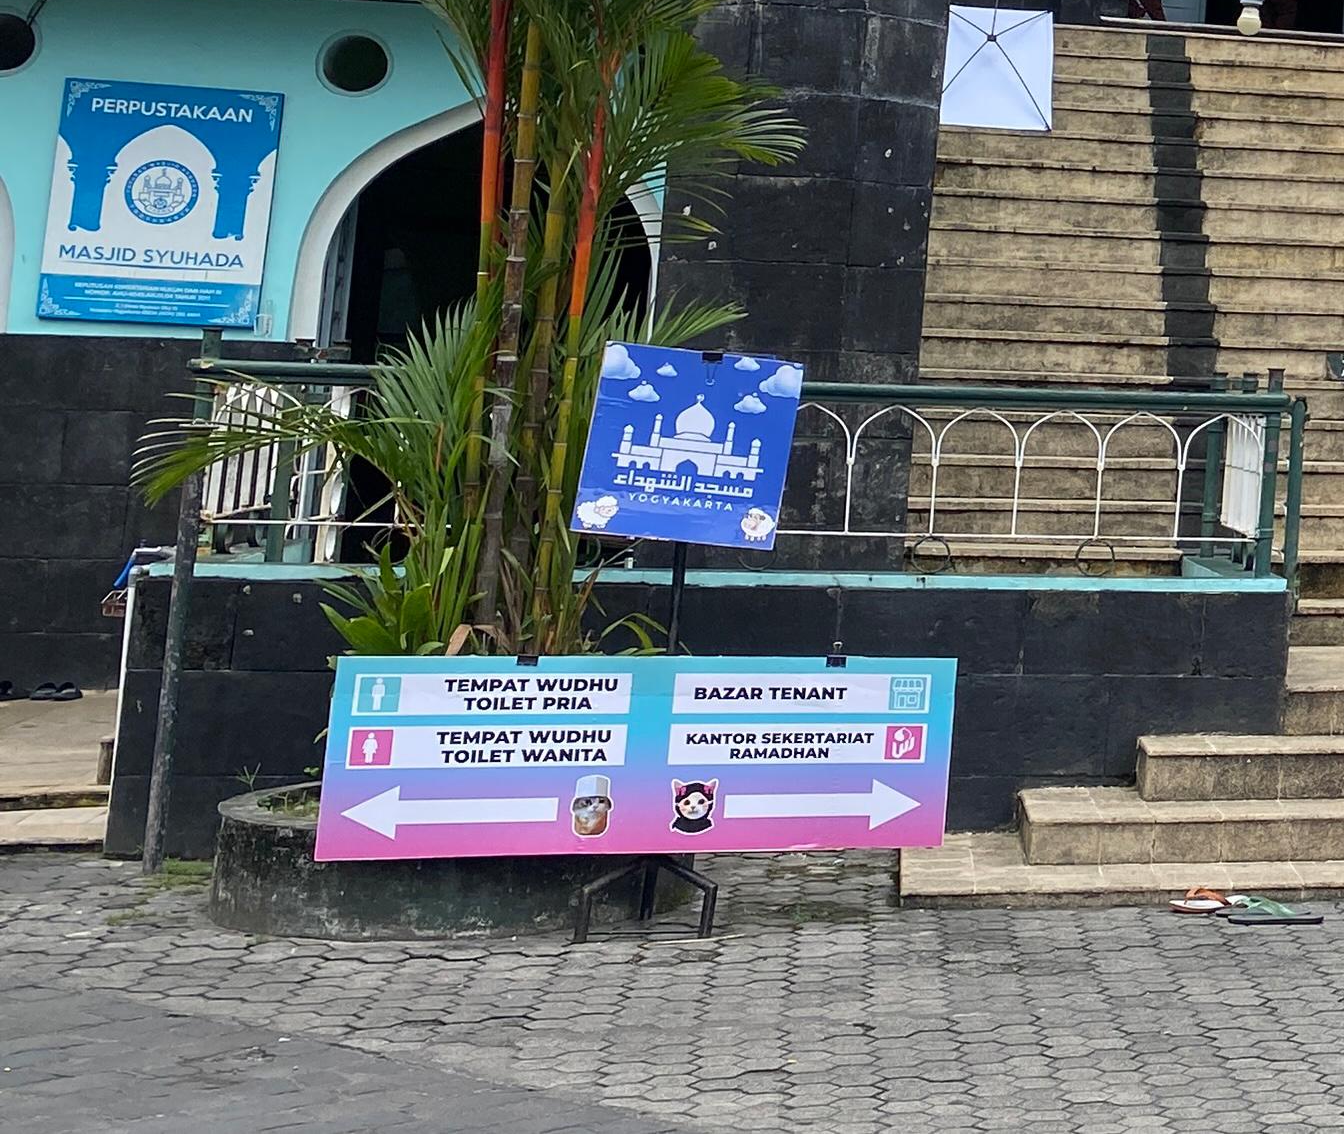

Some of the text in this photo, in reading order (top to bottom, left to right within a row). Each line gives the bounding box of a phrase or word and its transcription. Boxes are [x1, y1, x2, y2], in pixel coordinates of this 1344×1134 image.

[91, 98, 253, 123] PERPUSTAKAAN
[58, 244, 244, 268] MASJID SYUHADA
[613, 469, 753, 499] مسجد الشهداء
[627, 492, 733, 512] YOGYAKARTA
[444, 678, 618, 692] TEMPAT WUDHU
[694, 687, 847, 700] BAZAR TENANT
[464, 697, 592, 711] TOILET PRIA
[436, 729, 612, 745] TEMPAT WUDHU
[686, 732, 875, 745] KANTOR SEKERTARIAT
[441, 748, 608, 763] TOILET WANITA
[729, 747, 830, 759] RAMADHAN
